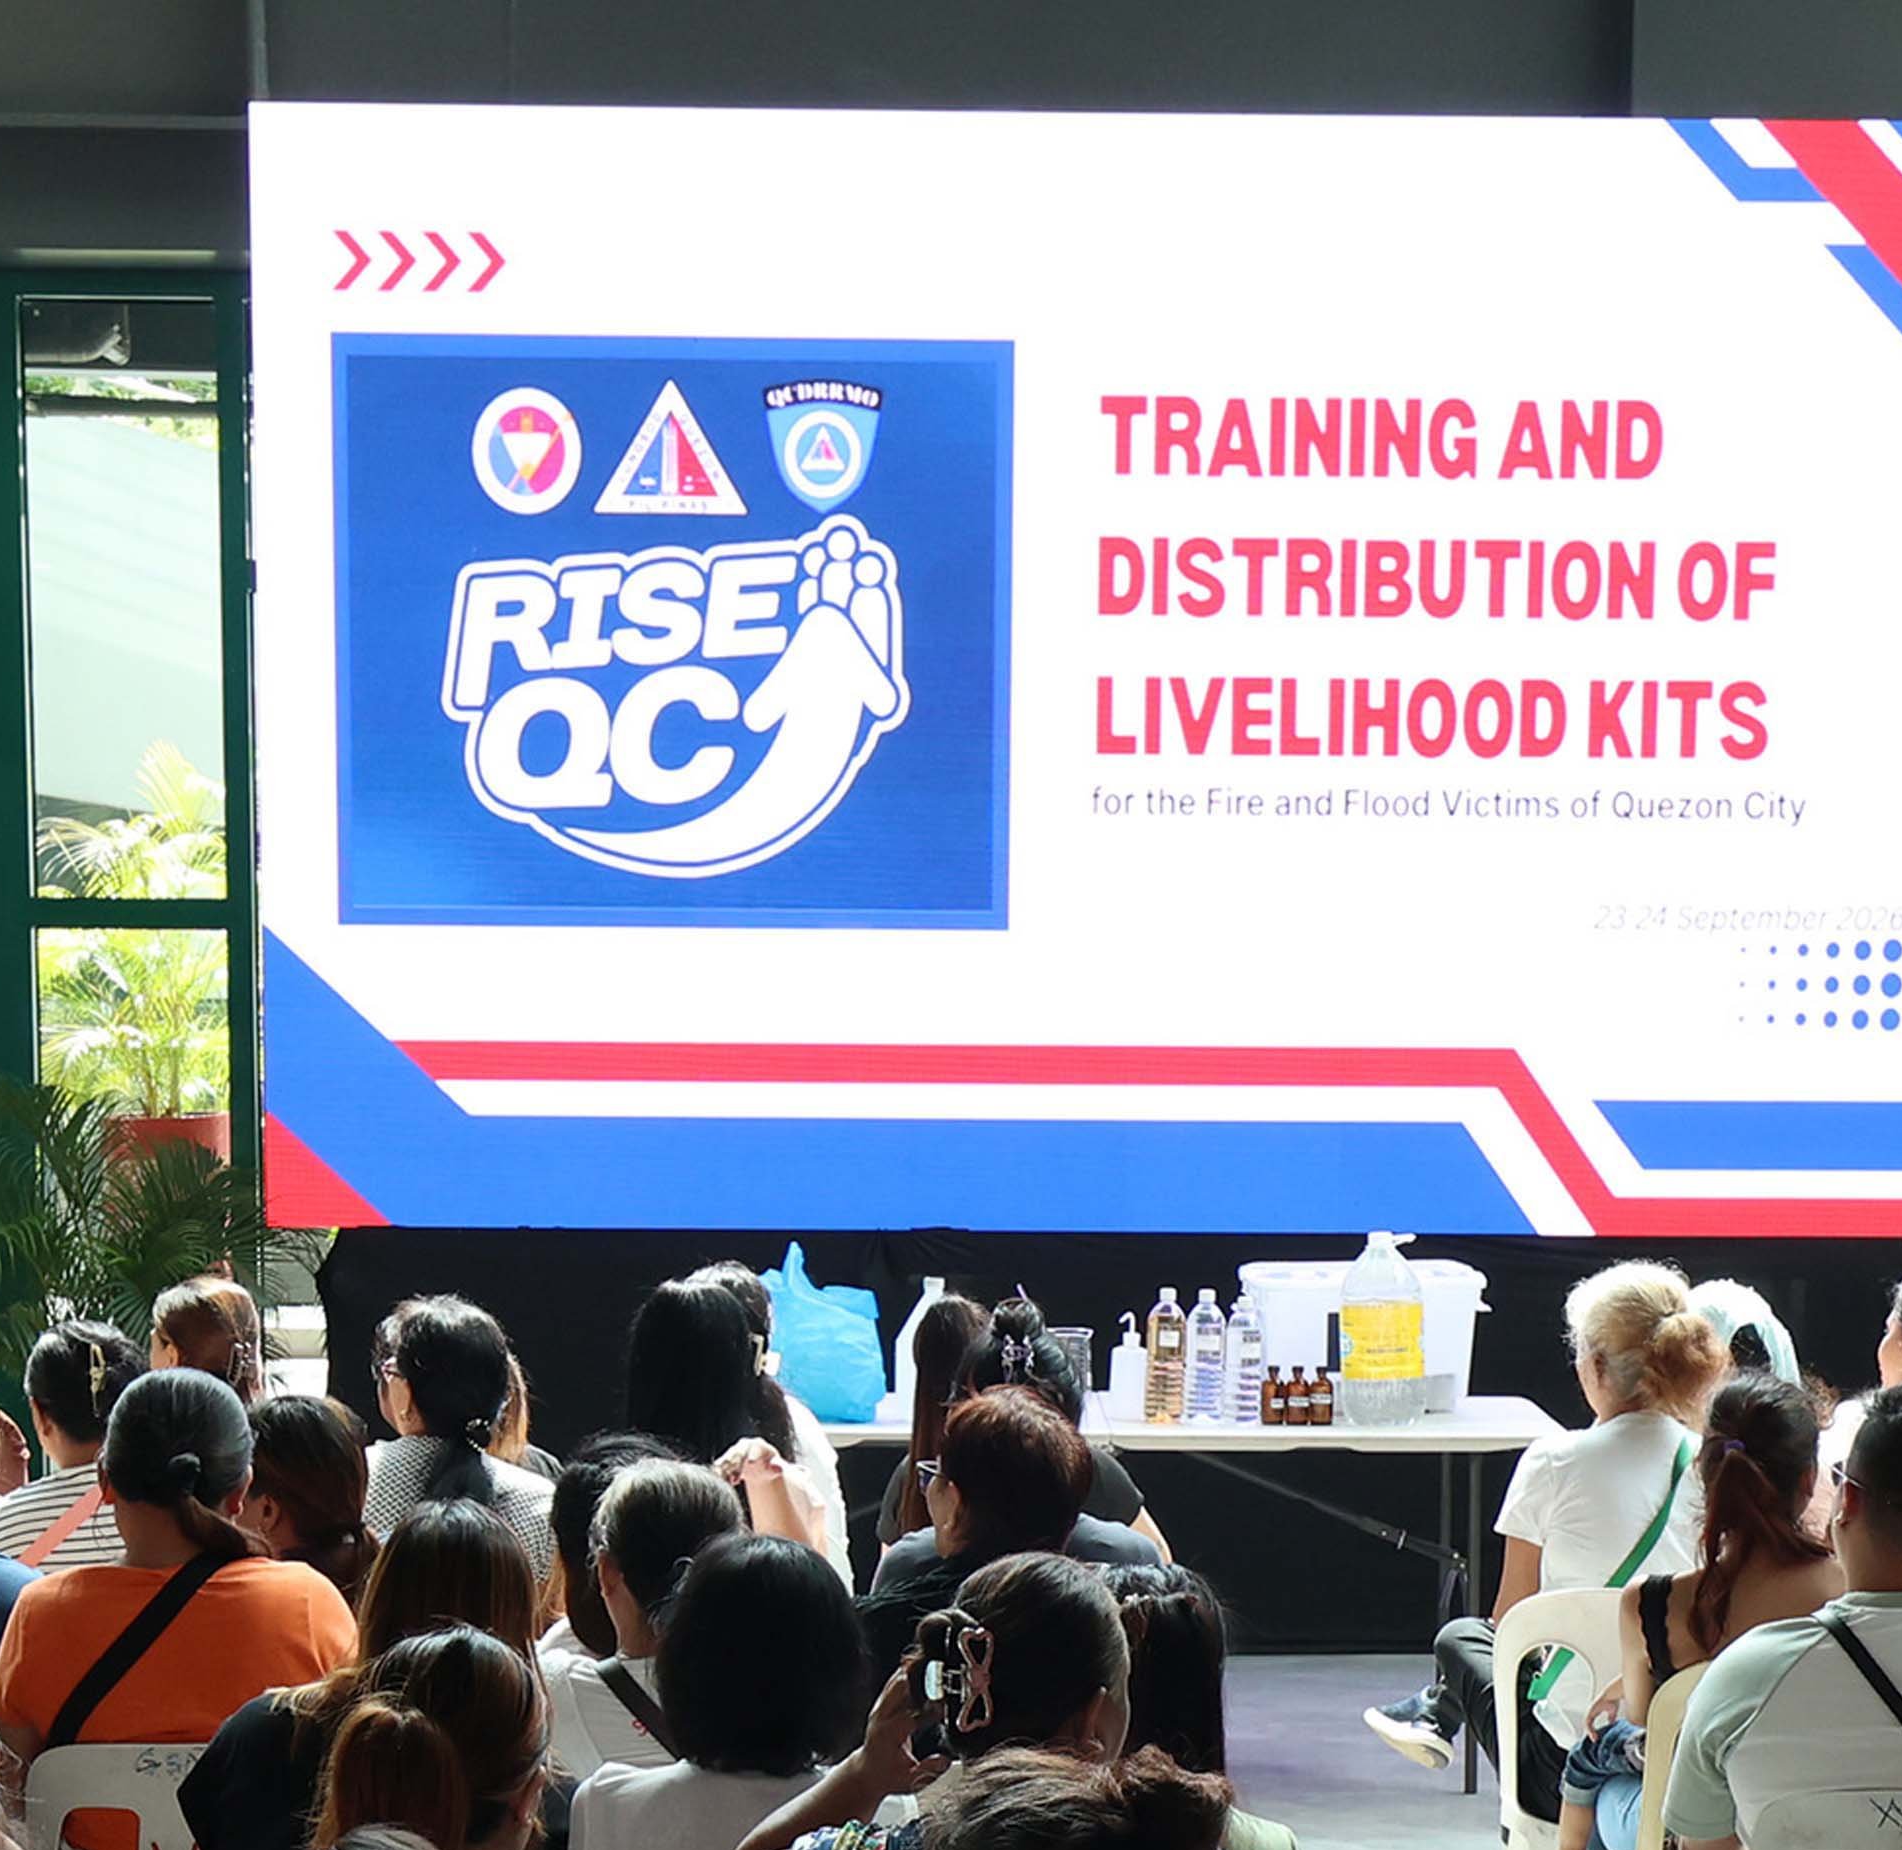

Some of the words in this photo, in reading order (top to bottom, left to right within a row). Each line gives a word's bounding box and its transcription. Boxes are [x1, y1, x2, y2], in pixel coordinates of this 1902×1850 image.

[1102, 394, 1478, 481] TRAINING
[1498, 399, 1664, 481] AND
[1097, 535, 1657, 622] DISTRIBUTION
[1678, 541, 1777, 622] OF
[453, 553, 799, 708] RISE
[476, 664, 740, 810] QC
[1096, 675, 1568, 760] LIVELIHOOD
[1587, 680, 1769, 761] KITS
[1092, 785, 1135, 816] for
[1146, 787, 1196, 816] the
[1206, 787, 1264, 817] Fire
[1274, 788, 1333, 817] and
[1343, 788, 1430, 818] Flood
[1442, 789, 1560, 819] Victims
[1570, 789, 1601, 820] of
[1611, 790, 1733, 821] Quezon
[1743, 791, 1806, 827] City
[1676, 904, 1829, 938] September
